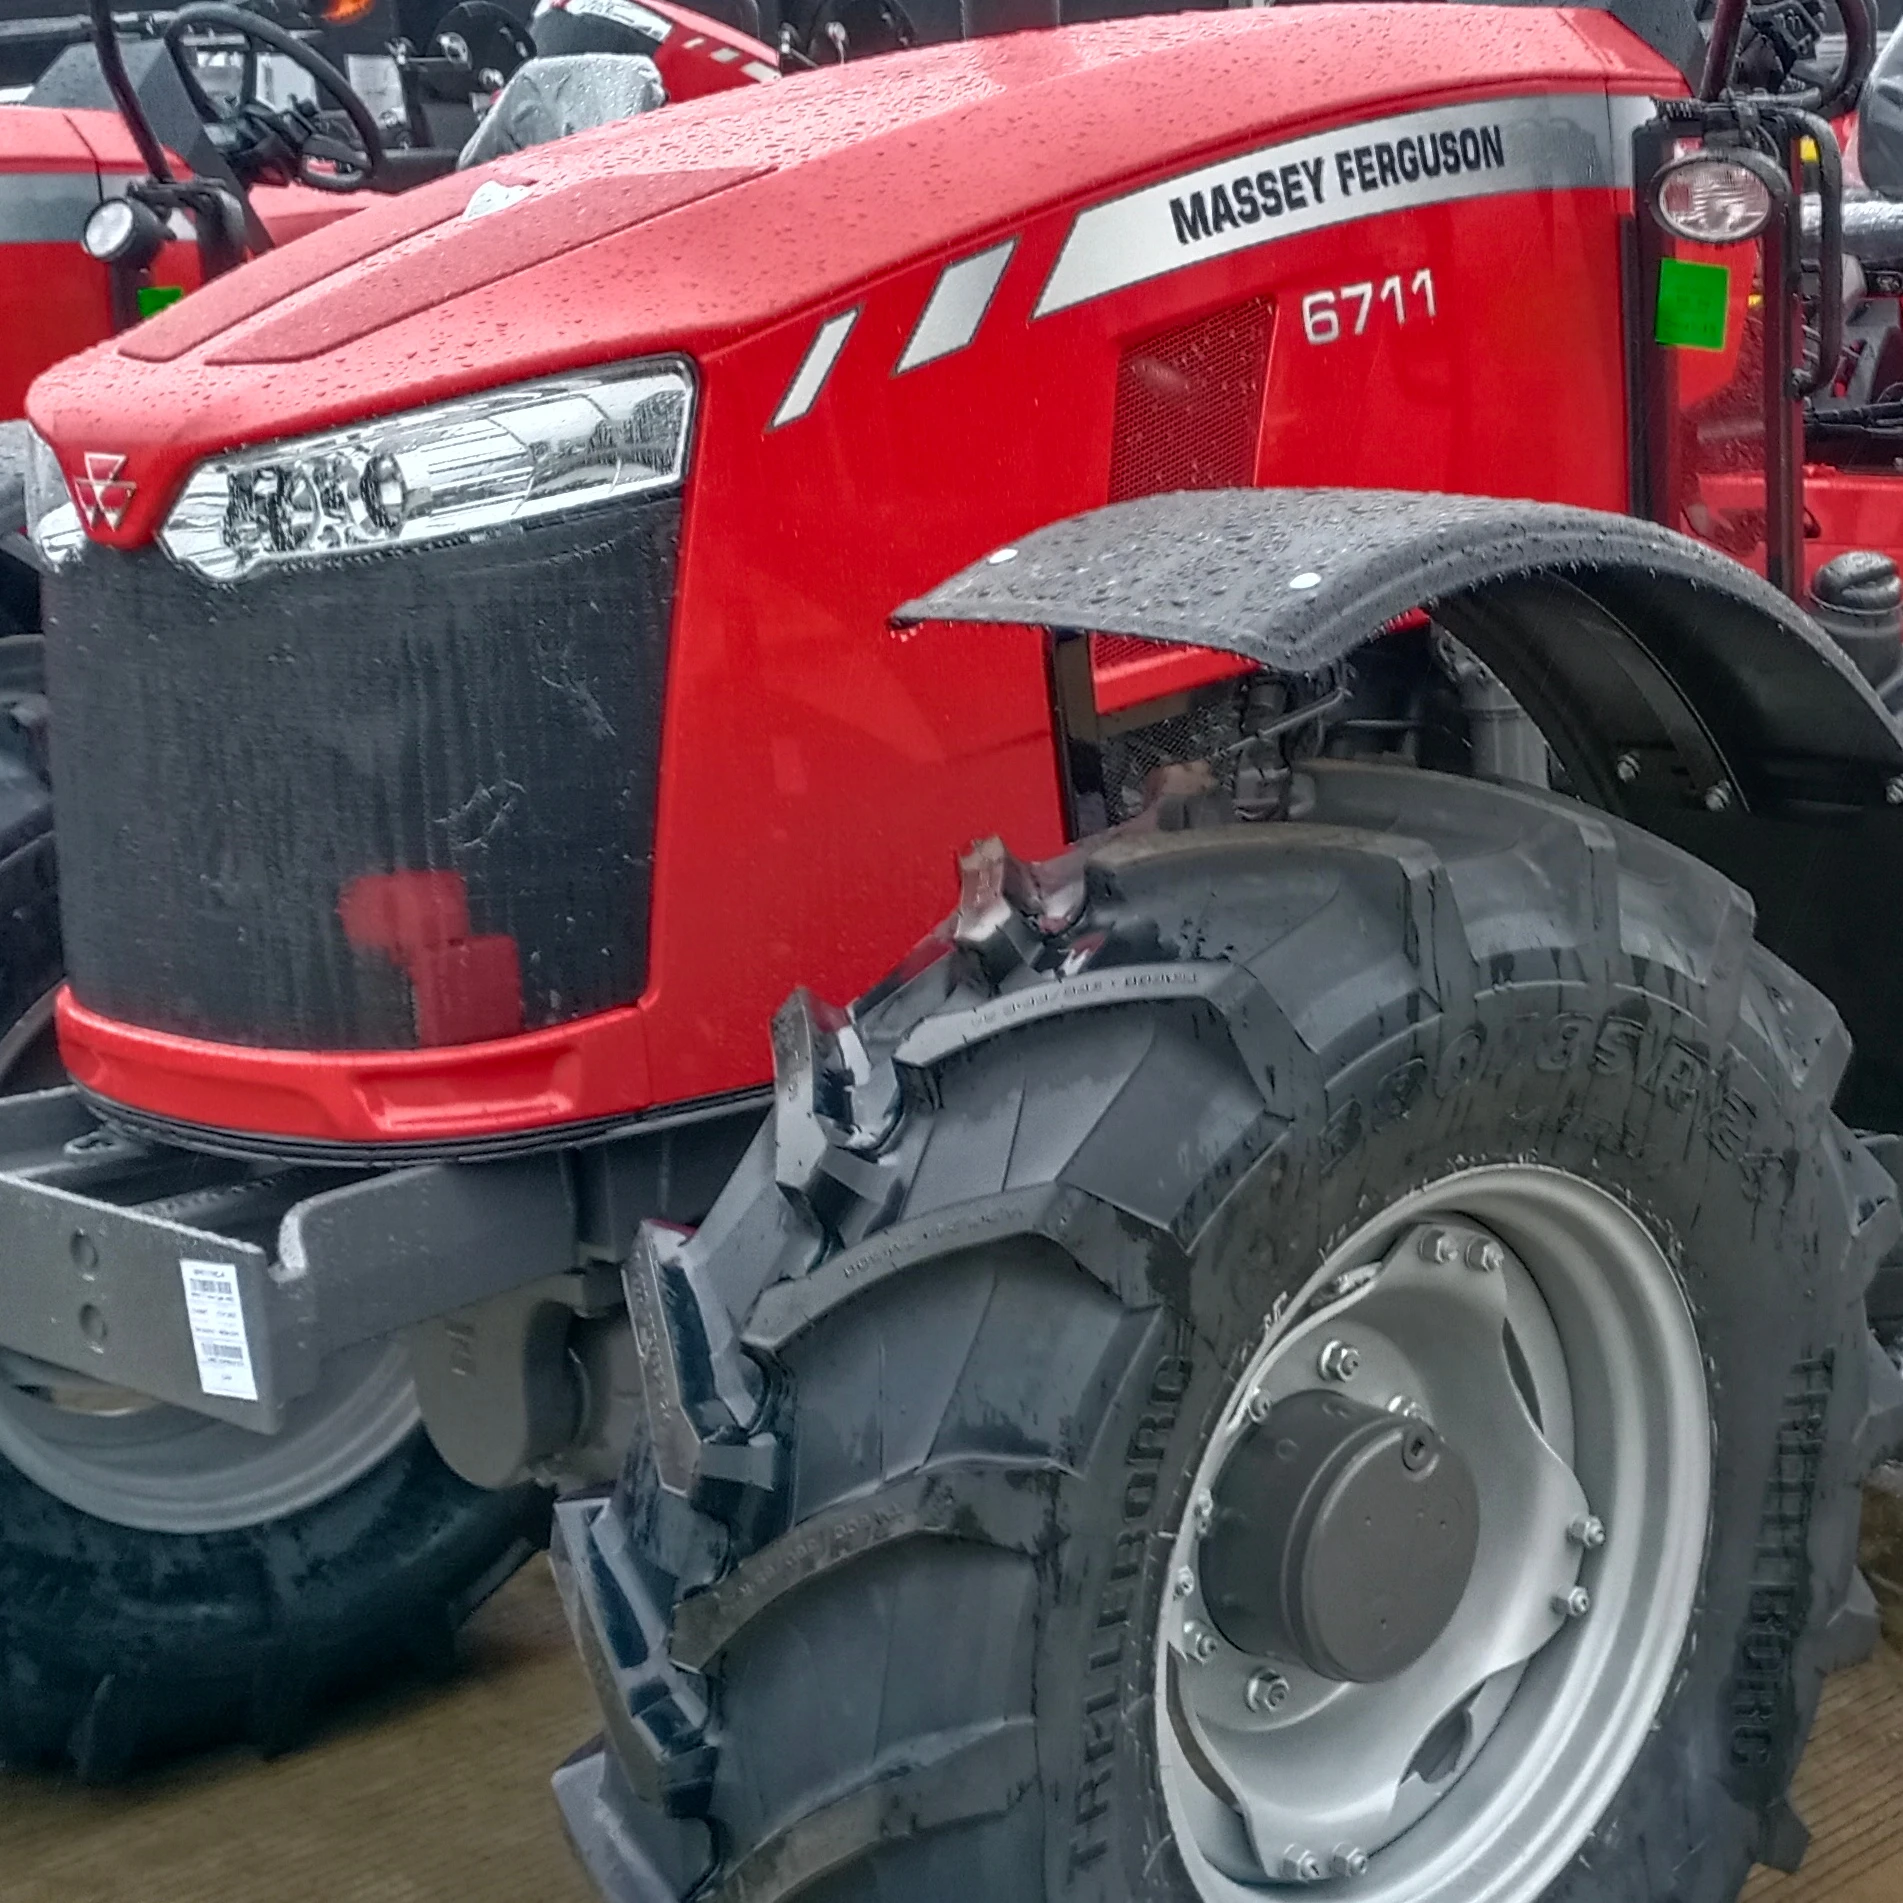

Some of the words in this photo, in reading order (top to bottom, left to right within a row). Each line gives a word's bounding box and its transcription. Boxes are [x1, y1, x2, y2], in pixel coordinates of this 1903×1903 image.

[1169, 156, 1326, 244] MASSEY
[1335, 125, 1505, 196] FERGUSON
[1302, 268, 1437, 345] 6711
